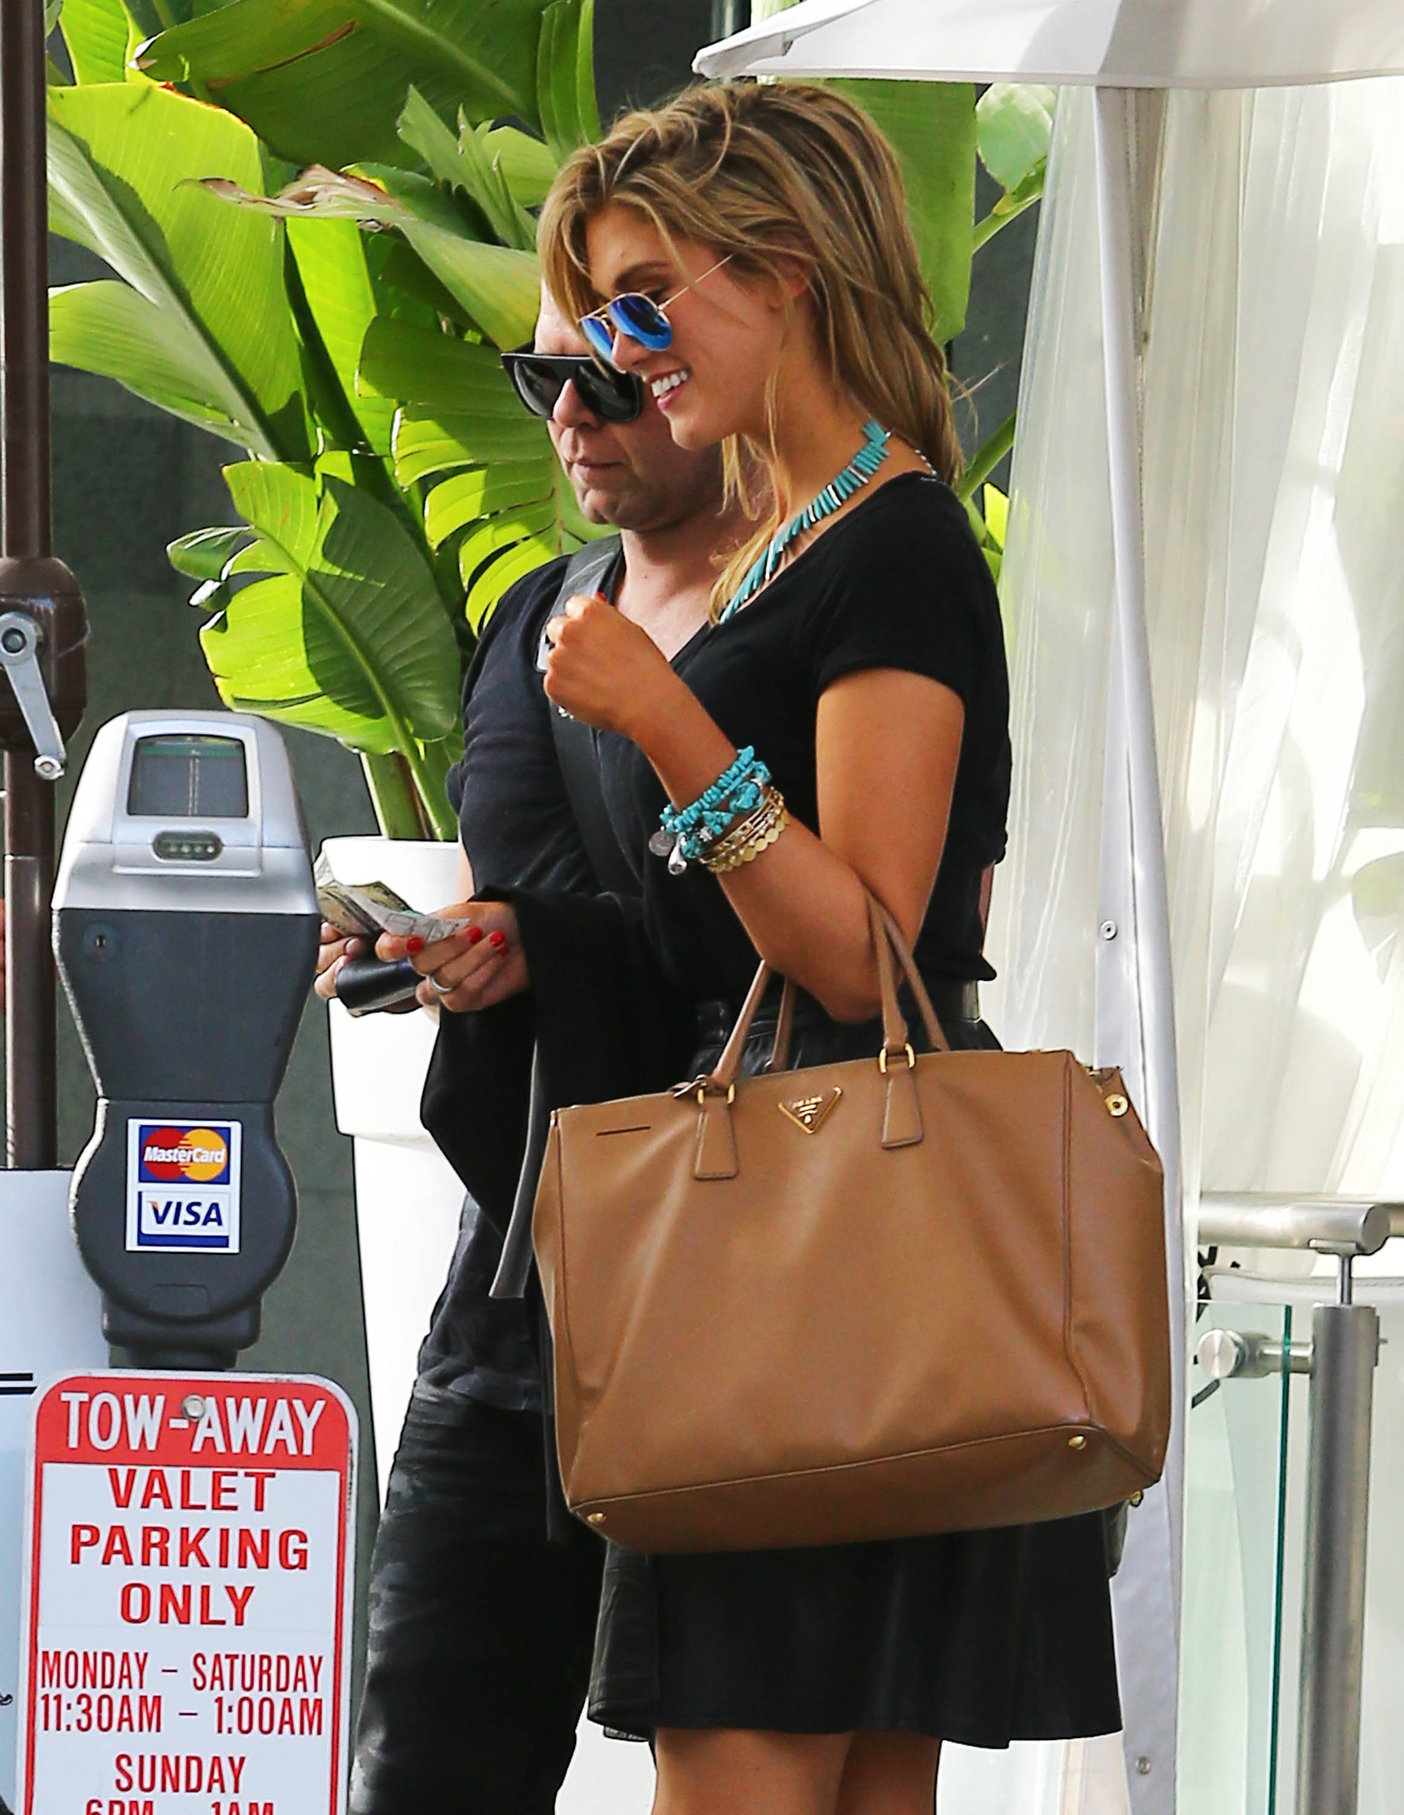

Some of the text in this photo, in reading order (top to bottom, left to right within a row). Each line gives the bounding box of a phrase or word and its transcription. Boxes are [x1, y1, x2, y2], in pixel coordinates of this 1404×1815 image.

[143, 1146, 226, 1164] MasterCard
[147, 1201, 223, 1226] VISA
[60, 1392, 326, 1456] TOW-AWAY
[108, 1468, 276, 1512] VALET
[70, 1524, 309, 1570] PARKING
[120, 1583, 255, 1626] ONLY
[41, 1650, 149, 1690] MONDAY
[192, 1652, 324, 1693] SATURDAY
[41, 1693, 162, 1733] 11:30AM
[214, 1695, 323, 1736] 1:00AM
[114, 1753, 247, 1794] SUNDAY
